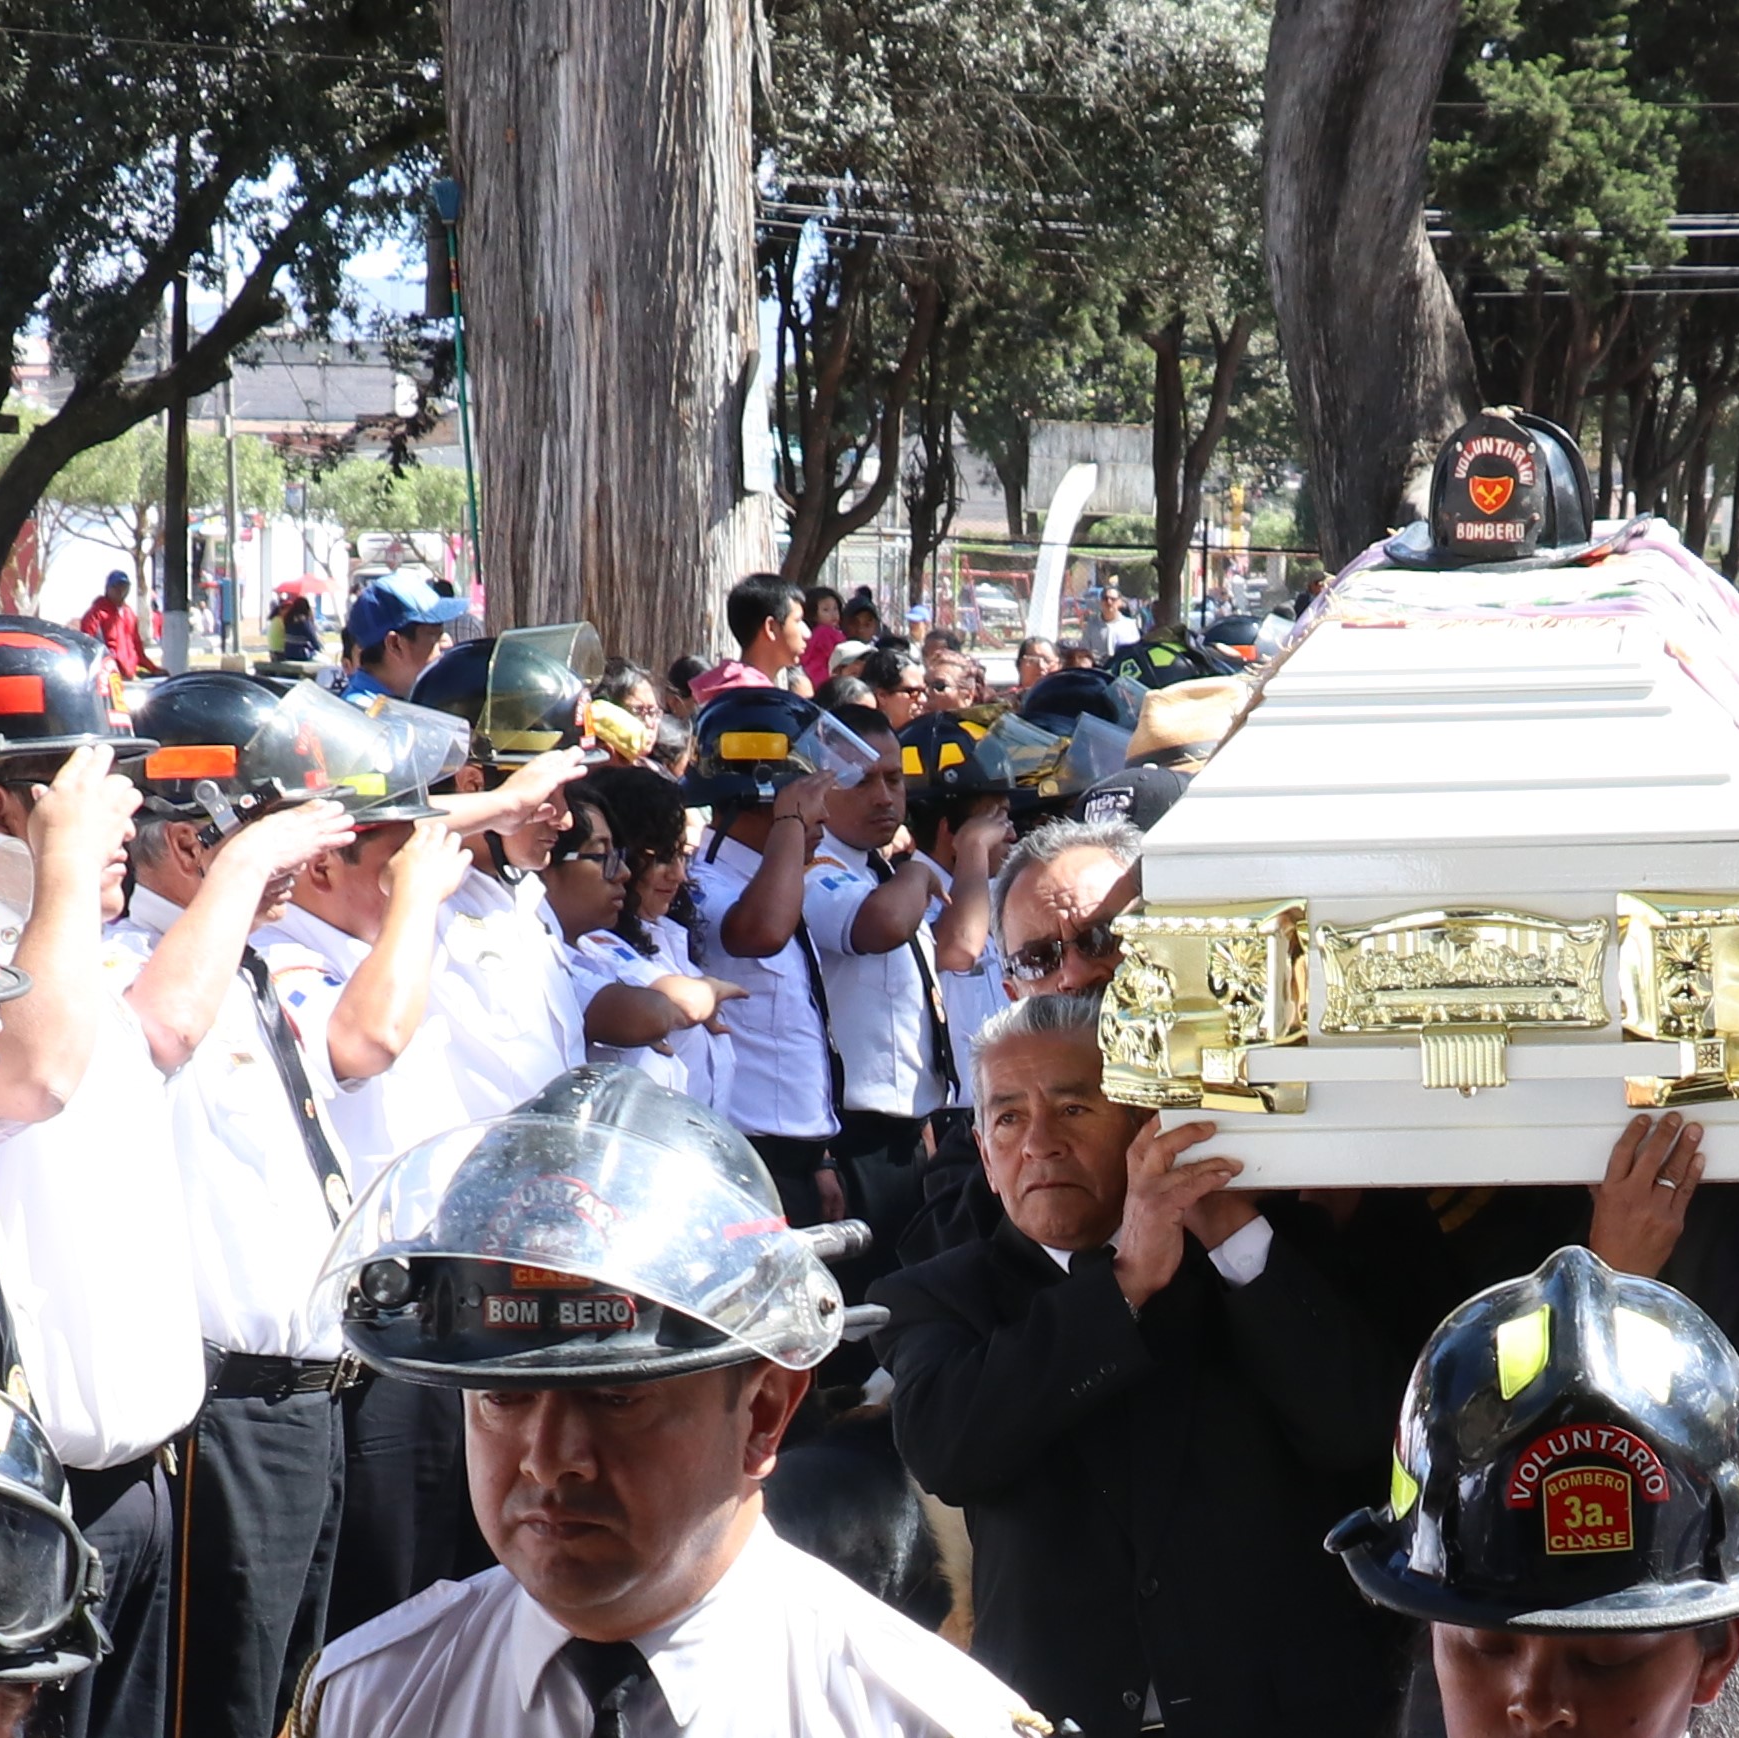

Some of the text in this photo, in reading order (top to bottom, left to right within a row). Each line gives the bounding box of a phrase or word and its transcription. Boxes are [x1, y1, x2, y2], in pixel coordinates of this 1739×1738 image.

[1455, 437, 1534, 486] VOLUNTARIO
[1456, 522, 1525, 541] BOMBERO
[1510, 1428, 1664, 1502] VOLUNTARIO
[1547, 1472, 1625, 1497] BOMBERO
[1564, 1496, 1614, 1528] 3a.
[1550, 1531, 1628, 1549] CLASE
